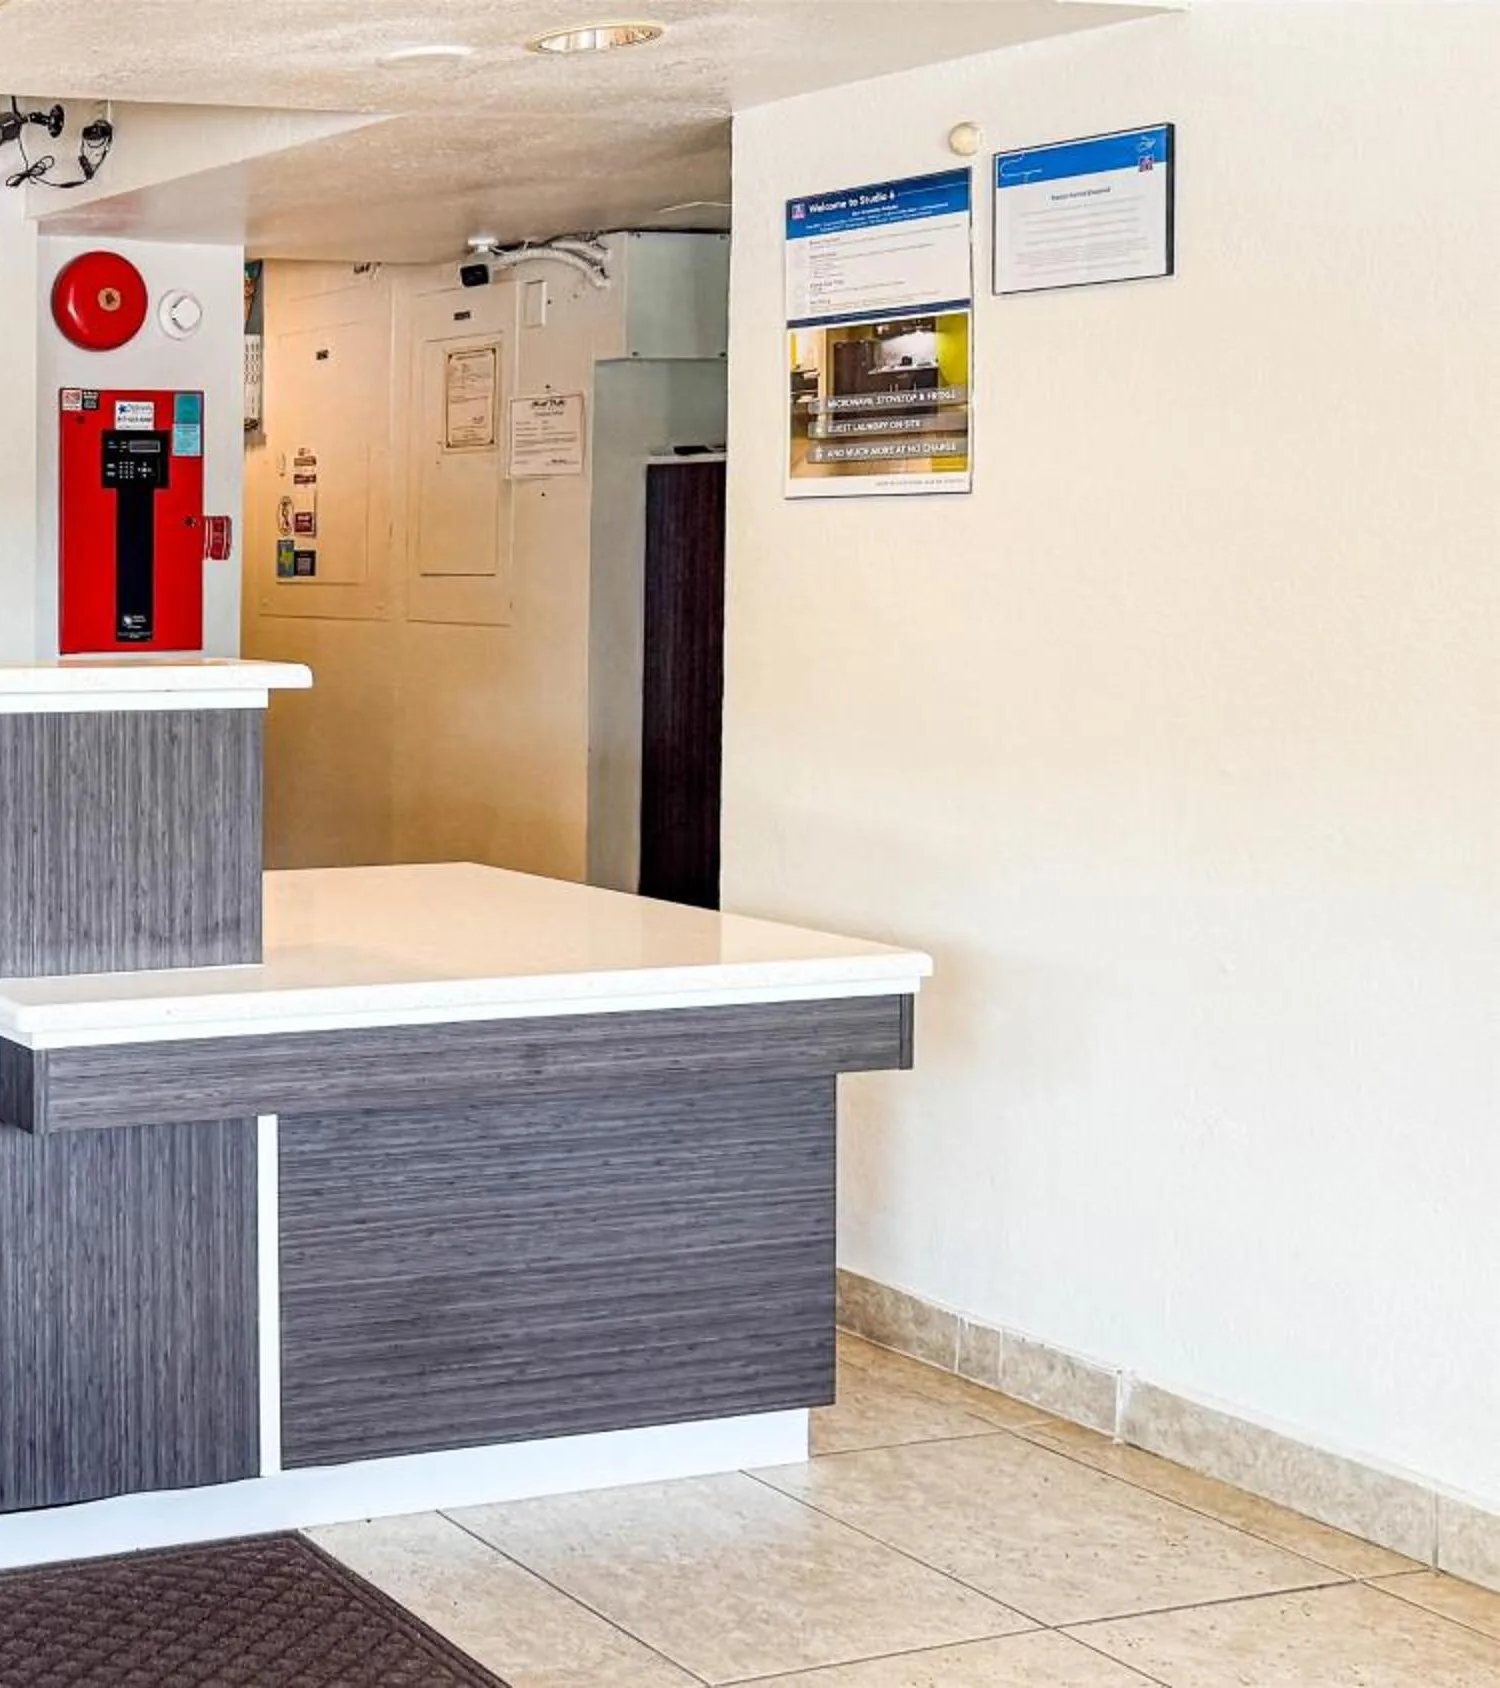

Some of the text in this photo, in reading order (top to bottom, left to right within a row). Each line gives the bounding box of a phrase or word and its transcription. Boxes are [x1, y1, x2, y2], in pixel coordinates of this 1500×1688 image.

[809, 200, 846, 213] Welcome
[849, 198, 858, 207] to
[860, 193, 887, 205] Studio
[828, 448, 844, 457] AND
